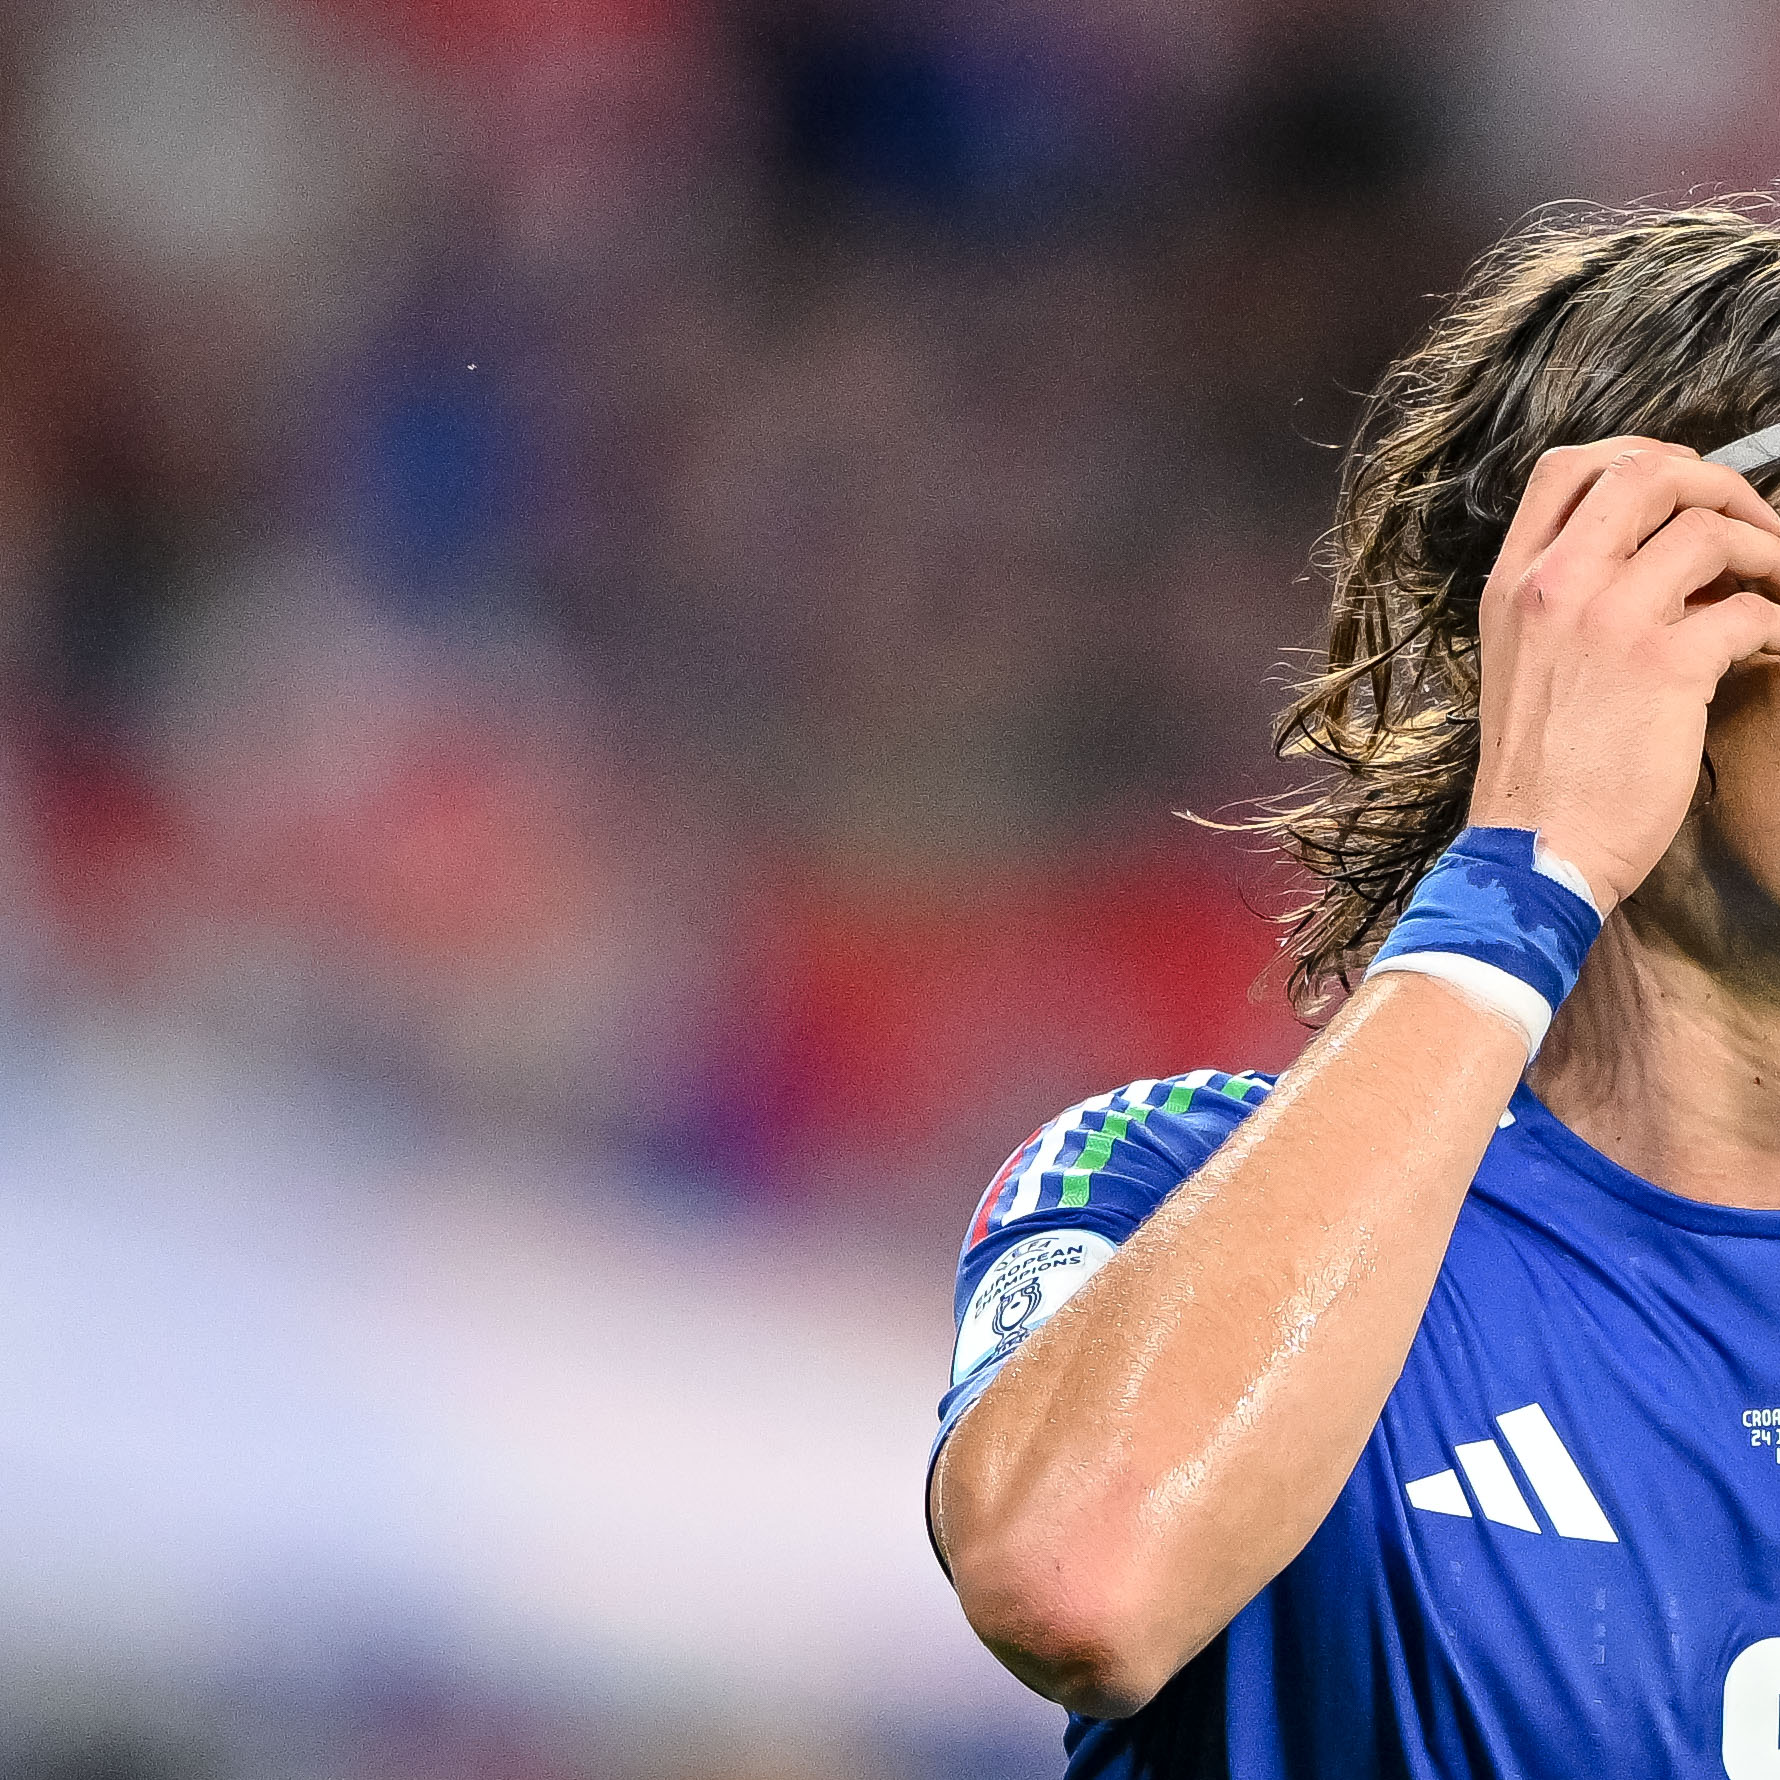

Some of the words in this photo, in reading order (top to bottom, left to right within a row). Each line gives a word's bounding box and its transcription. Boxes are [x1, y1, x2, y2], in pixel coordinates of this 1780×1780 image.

[974, 1255, 1082, 1320] CHAMPIONS
[975, 1244, 1084, 1311] EUROPEAN
[1750, 1429, 1772, 1447] 24
